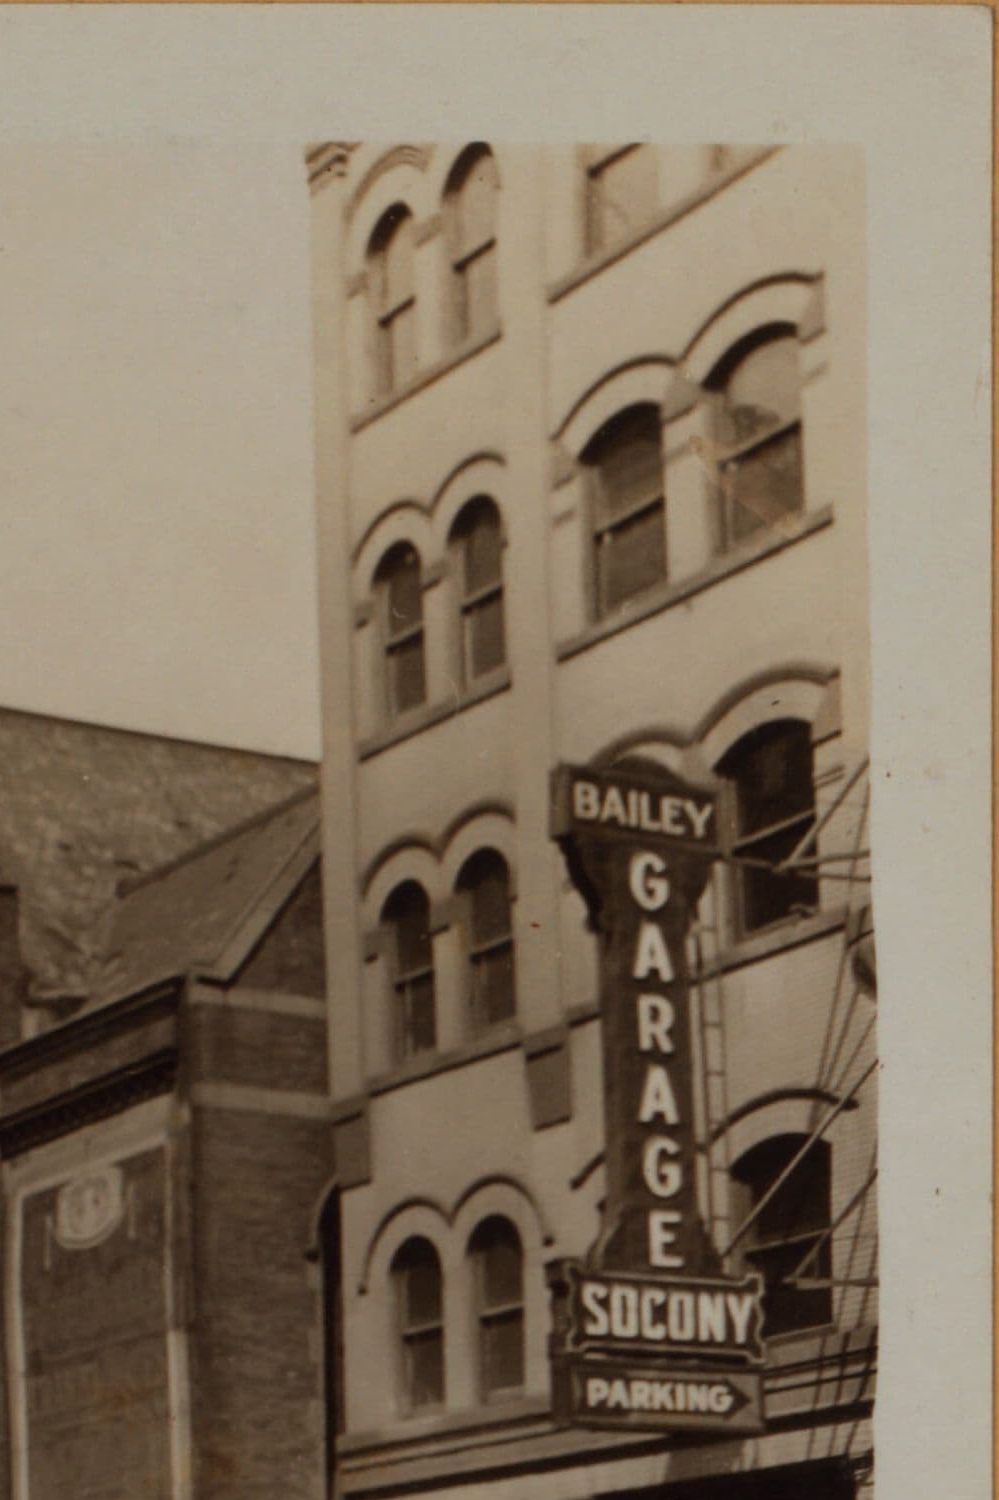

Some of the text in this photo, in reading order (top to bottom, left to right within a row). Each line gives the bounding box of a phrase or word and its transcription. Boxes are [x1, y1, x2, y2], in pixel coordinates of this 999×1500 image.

[573, 780, 713, 839] BAILEY
[628, 850, 685, 1269] GARAGE
[581, 1281, 753, 1345] SOCONY
[586, 1377, 735, 1413] PARKING
